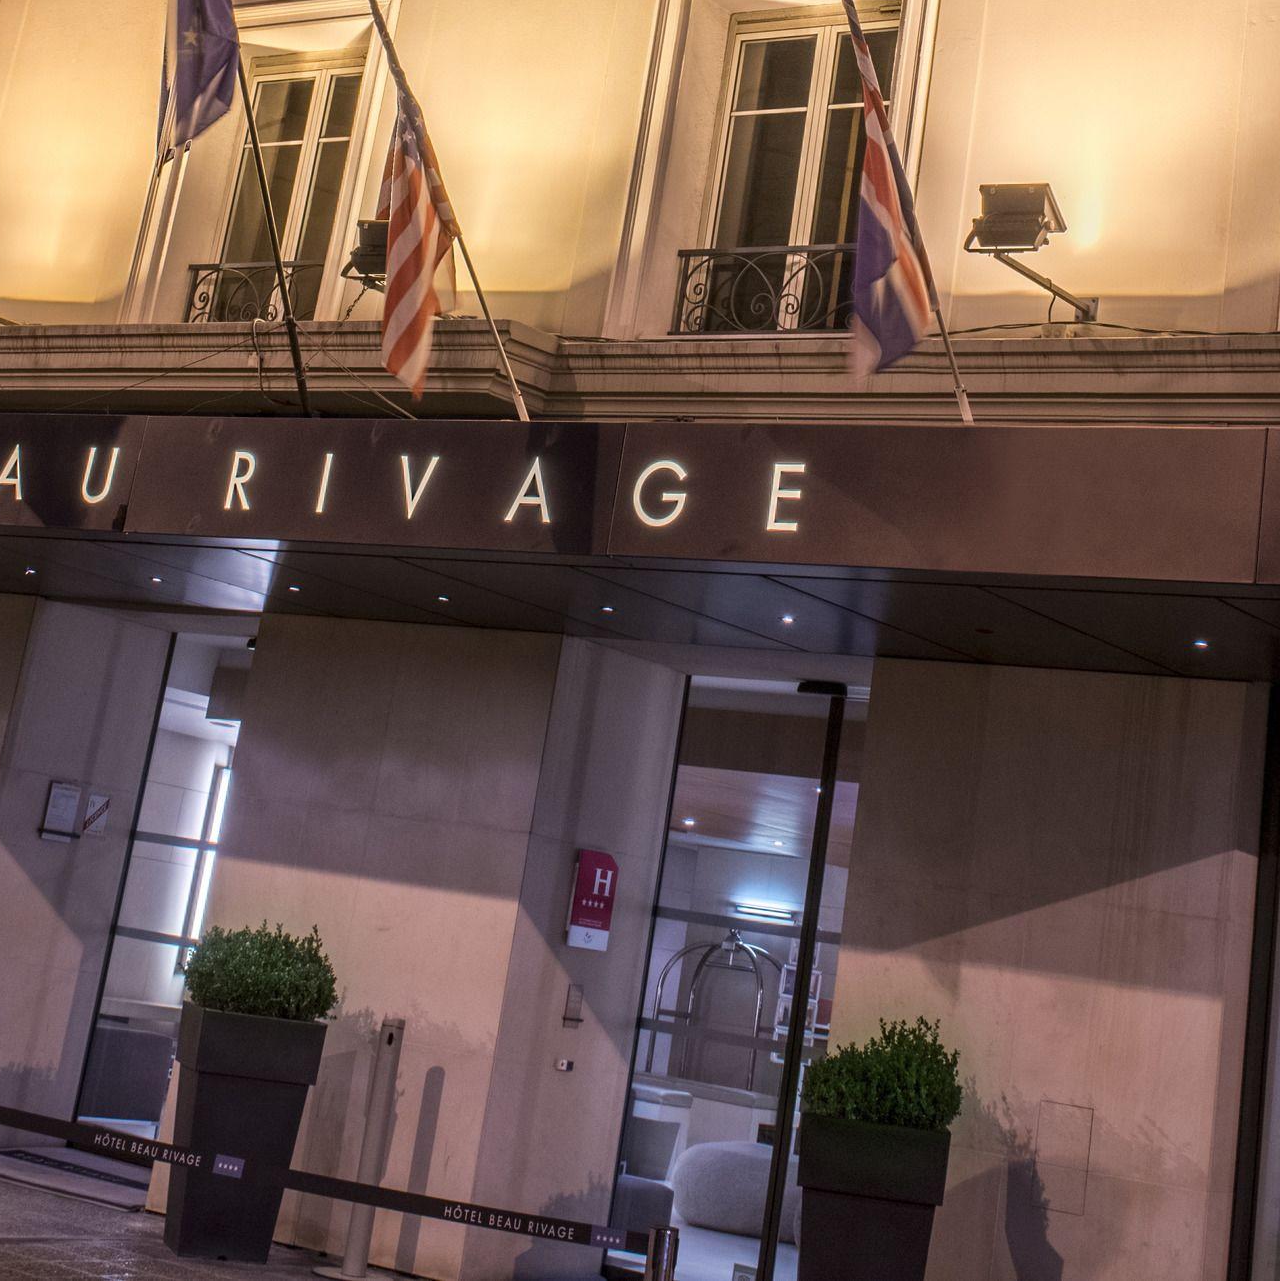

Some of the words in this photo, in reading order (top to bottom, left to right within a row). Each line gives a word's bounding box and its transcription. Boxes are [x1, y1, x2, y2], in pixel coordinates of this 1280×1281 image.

[223, 450, 807, 532] RIVAGE
[592, 868, 614, 897] H
[94, 1133, 126, 1151] HÔTEL
[131, 1142, 158, 1158] BEAU
[162, 1149, 202, 1167] RIVAGE
[444, 1205, 482, 1224] HÔTEL
[488, 1214, 521, 1231] BEAU
[528, 1221, 575, 1240] RIVAGE
